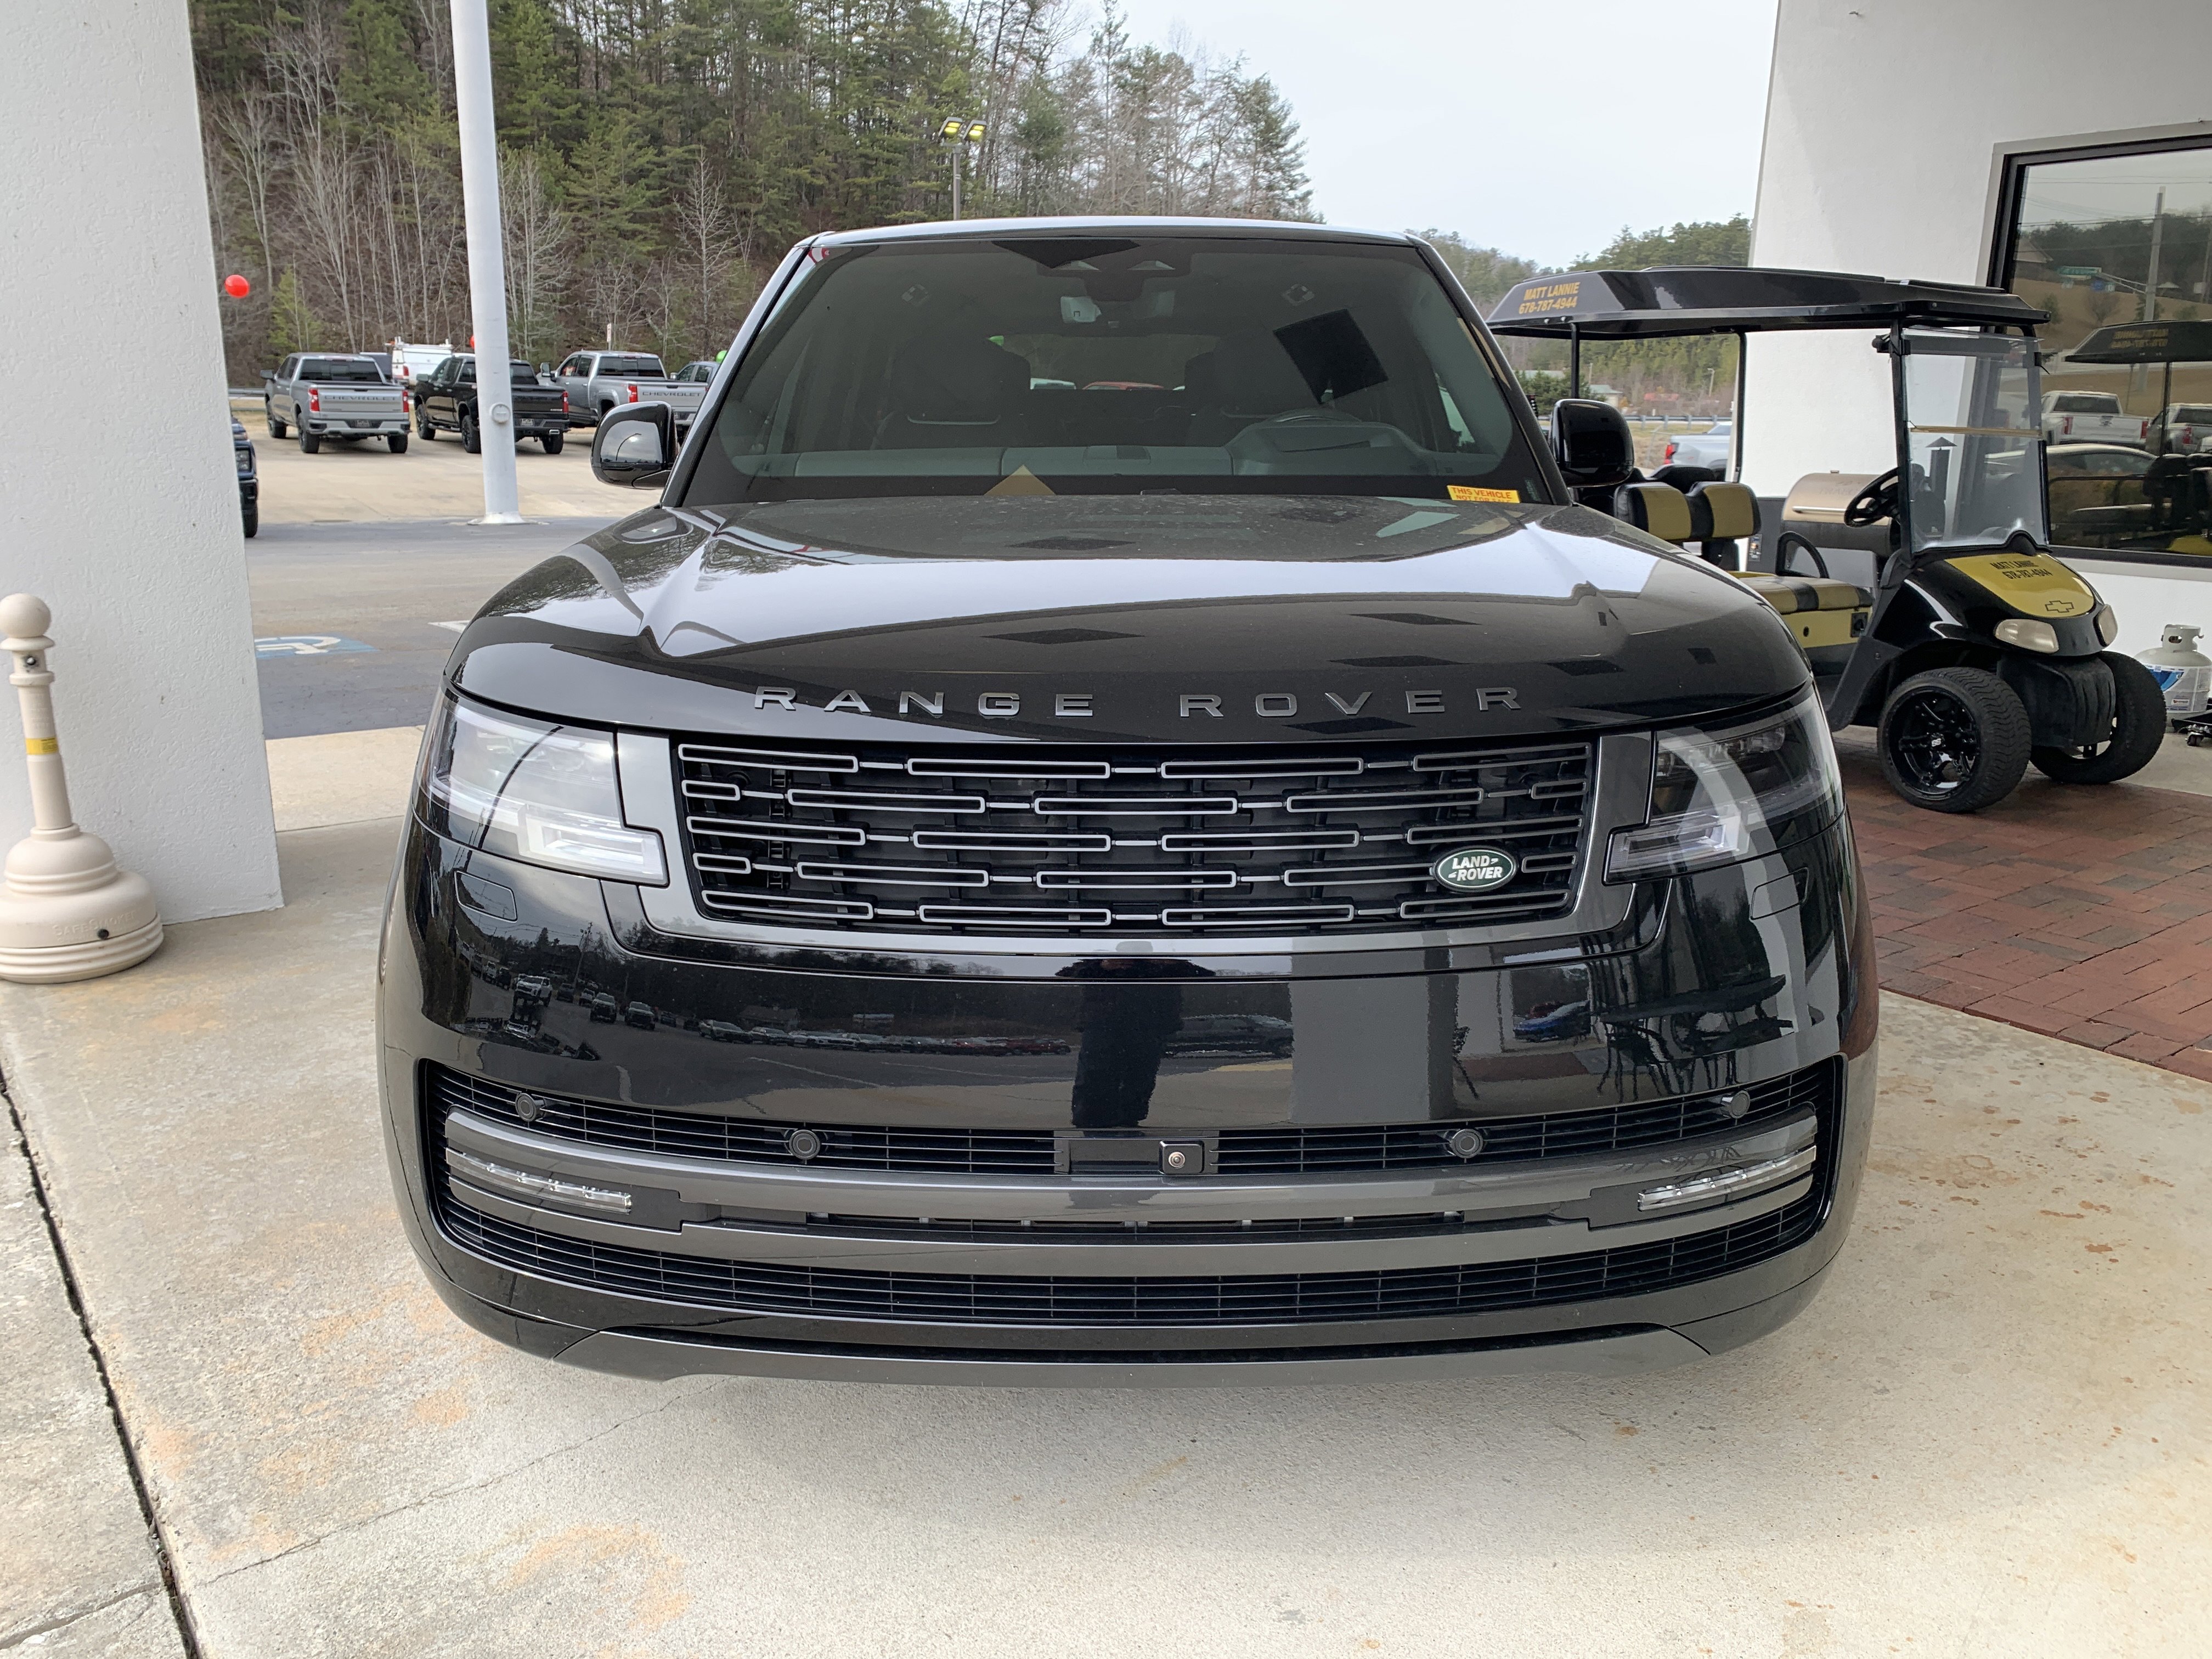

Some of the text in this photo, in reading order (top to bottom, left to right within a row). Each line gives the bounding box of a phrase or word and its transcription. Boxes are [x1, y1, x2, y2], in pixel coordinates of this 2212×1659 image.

[1523, 281, 1581, 301] MATT LANNIE
[1519, 296, 1578, 314] 678-787-4944
[1474, 489, 1513, 499] VEHICLE
[1990, 561, 2015, 569] MATT
[754, 686, 1521, 717] RANGE ROVER
[1452, 855, 1490, 870] LAND
[1457, 866, 1503, 882] ROVER
